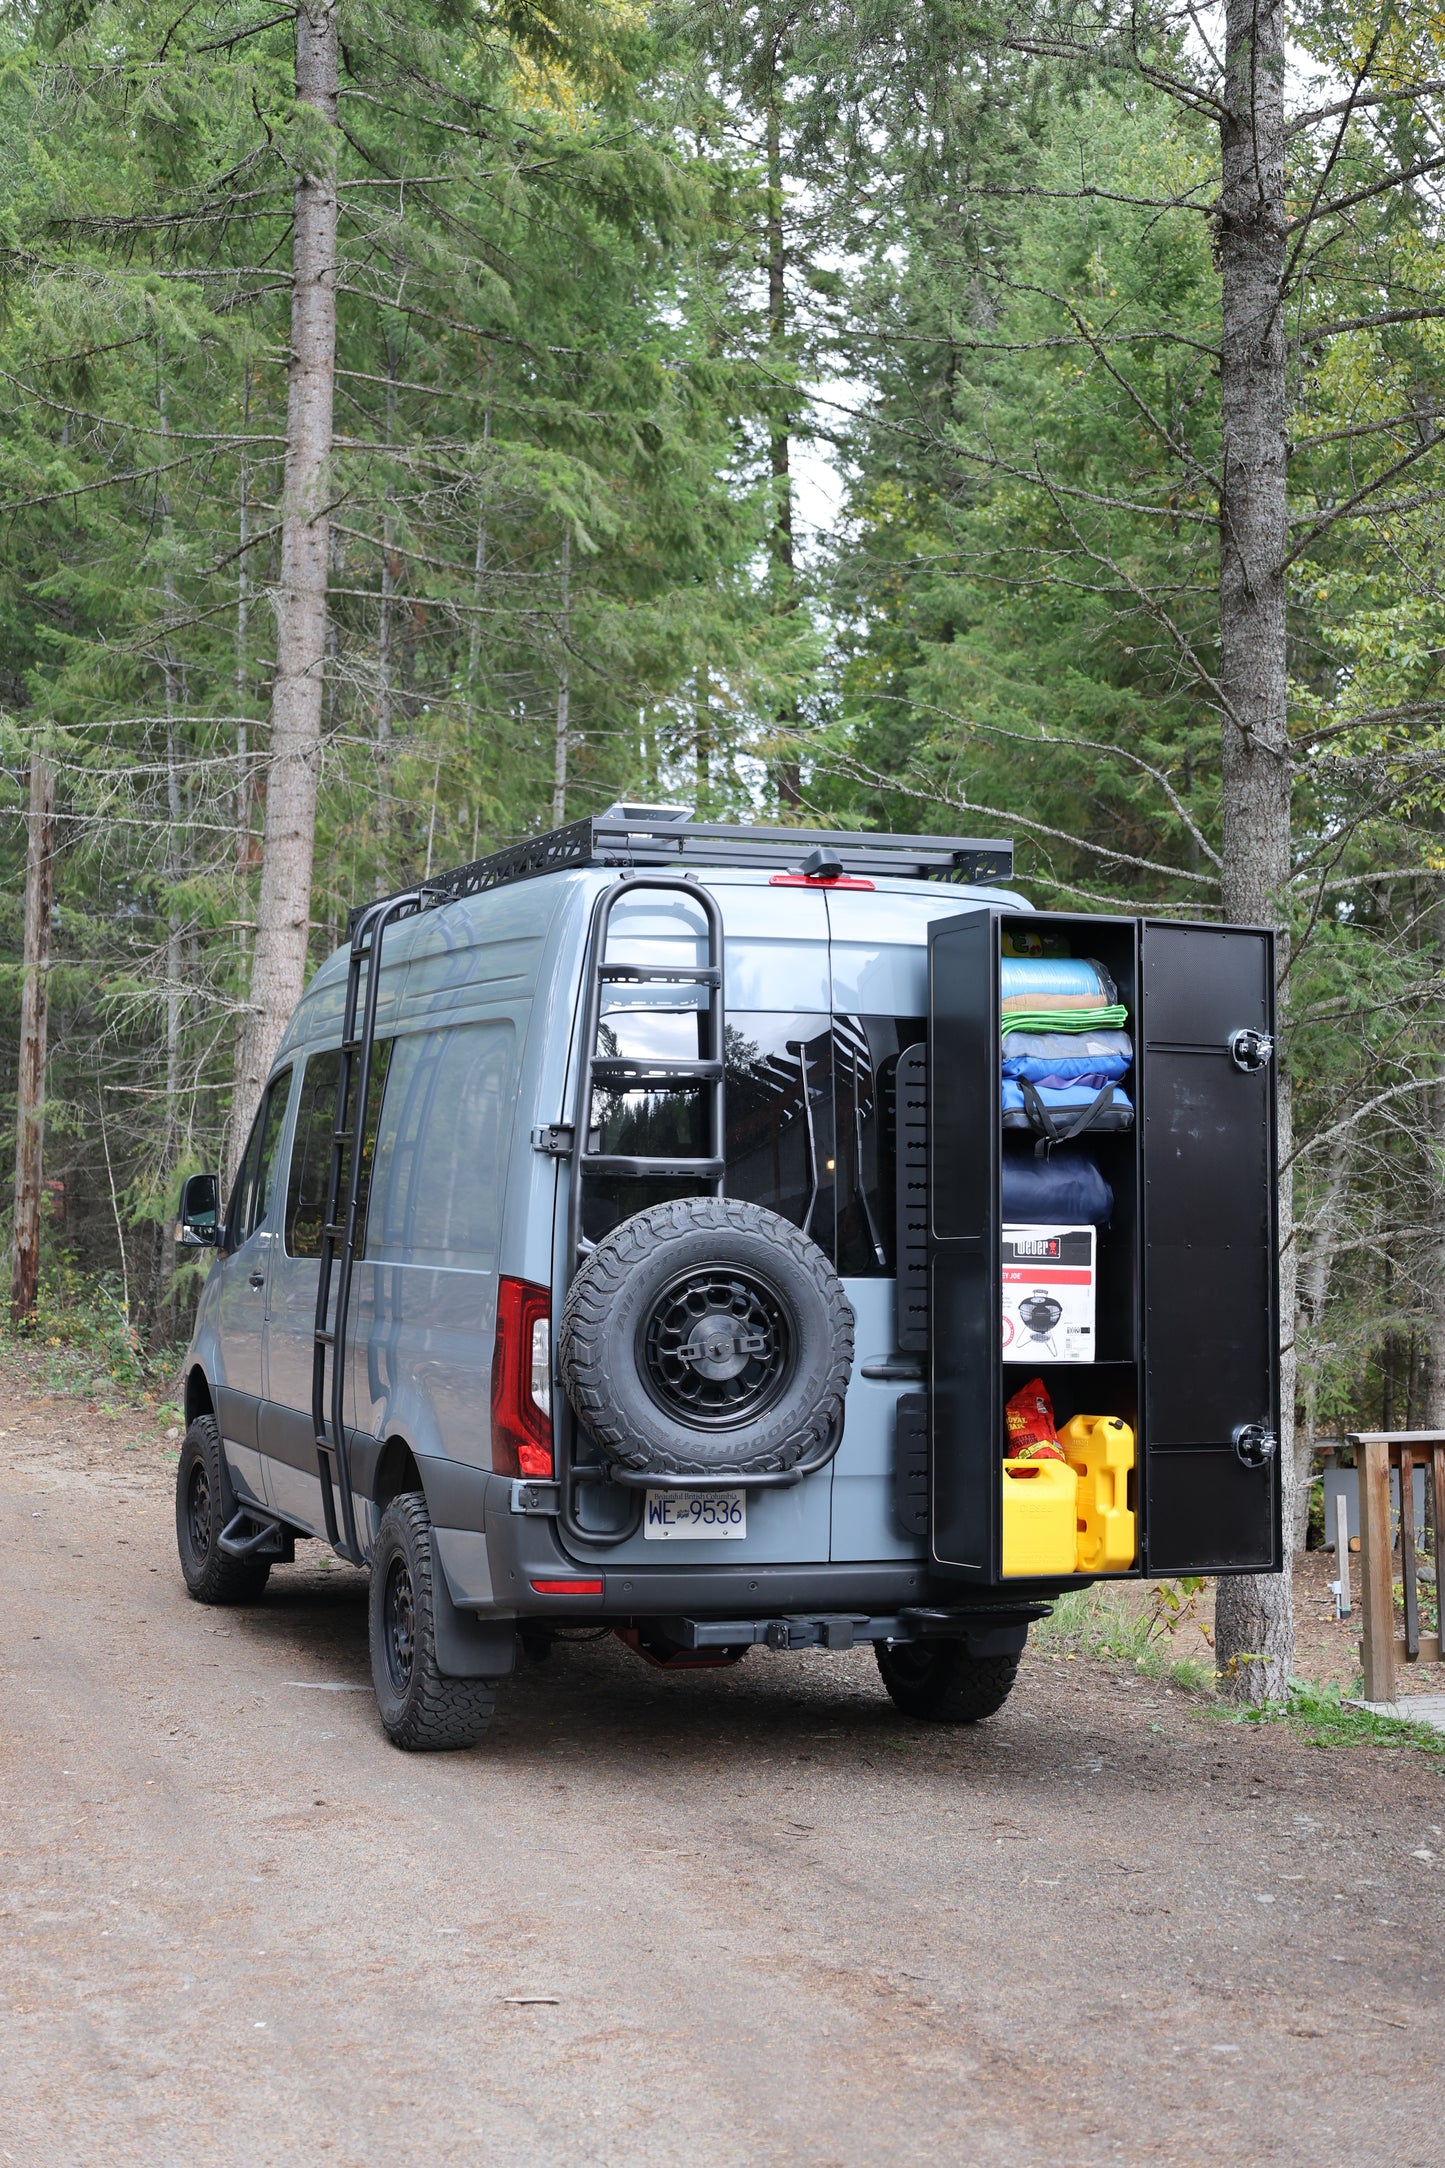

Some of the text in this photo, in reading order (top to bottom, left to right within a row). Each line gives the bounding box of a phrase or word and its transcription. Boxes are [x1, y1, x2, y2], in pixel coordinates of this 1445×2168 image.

[673, 1375, 819, 1456] BFGoodrich
[654, 1492, 737, 1500] Beautiful British Columbia
[649, 1500, 742, 1525] WE 9536
